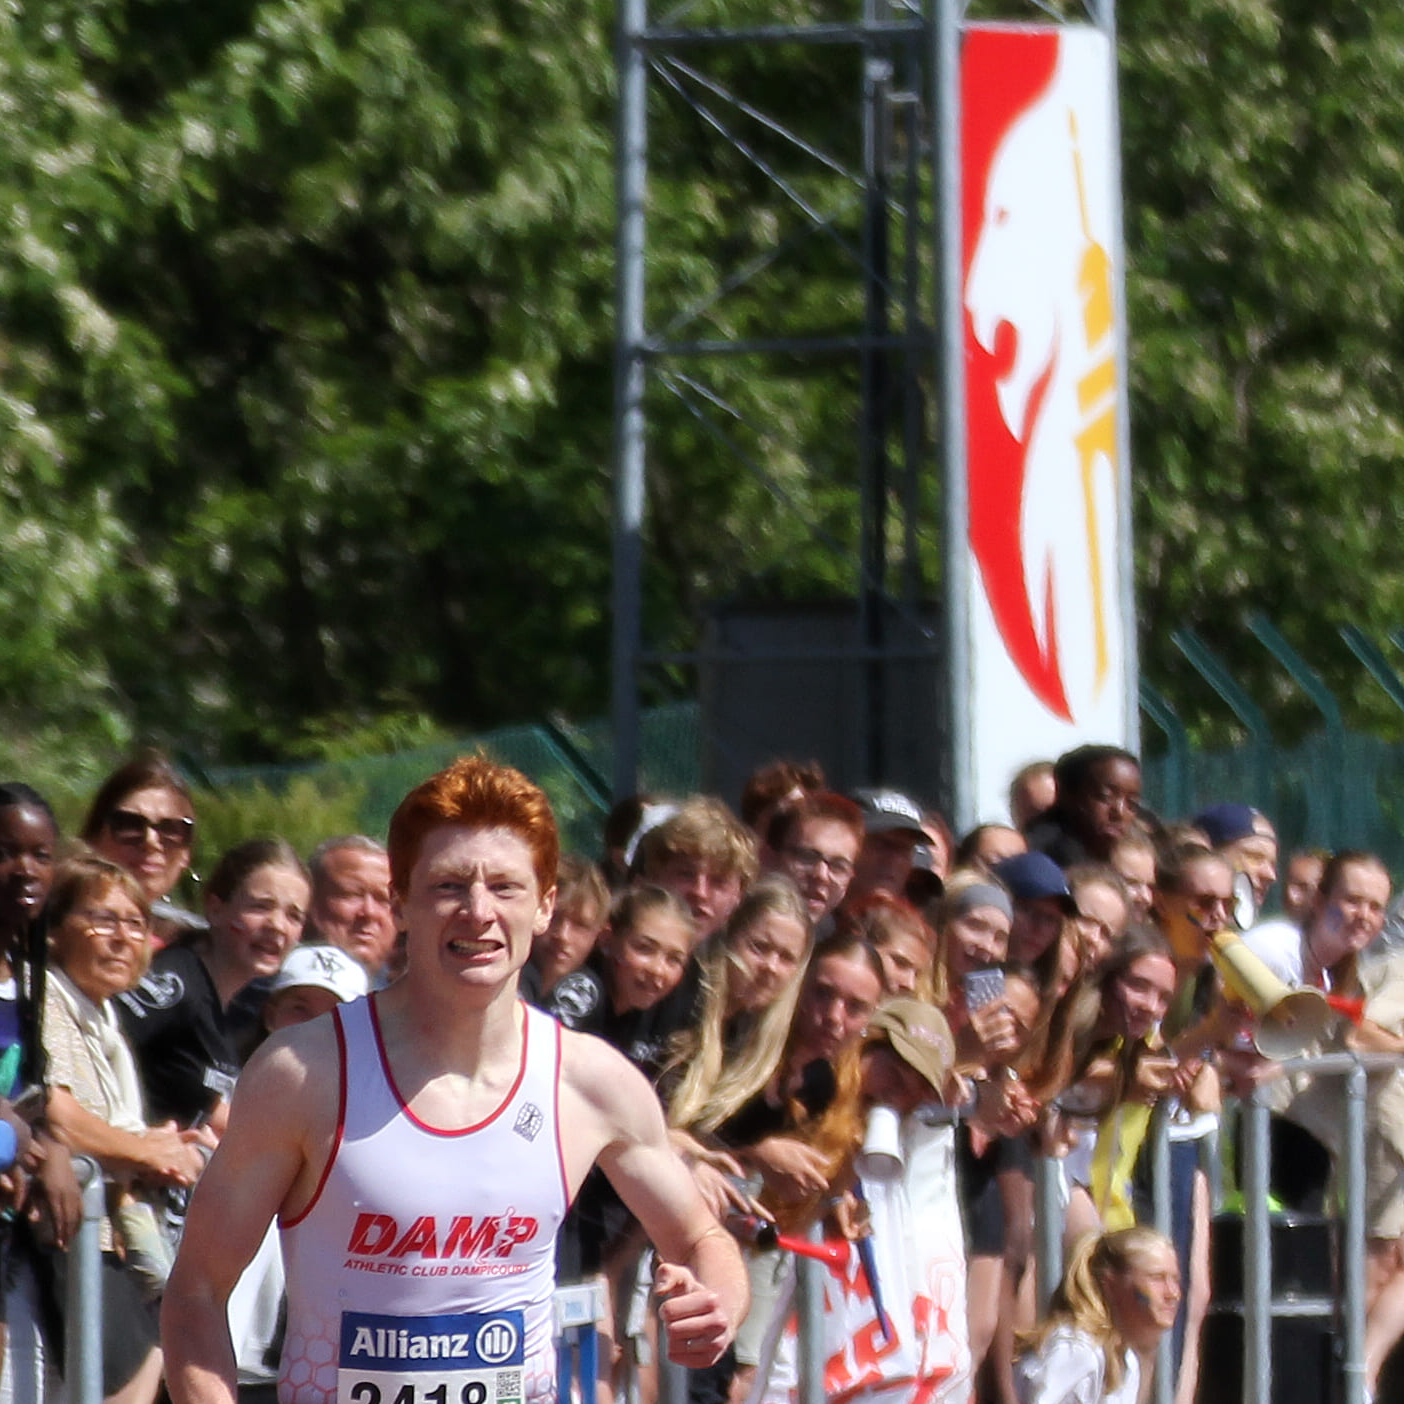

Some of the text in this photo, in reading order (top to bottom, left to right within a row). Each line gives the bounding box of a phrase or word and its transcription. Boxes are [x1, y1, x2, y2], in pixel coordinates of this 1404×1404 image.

[348, 1212, 539, 1260] DAMP
[343, 1258, 530, 1277] ATHLETIC CLUB DAMPICOURT
[349, 1326, 469, 1359] Allianz
